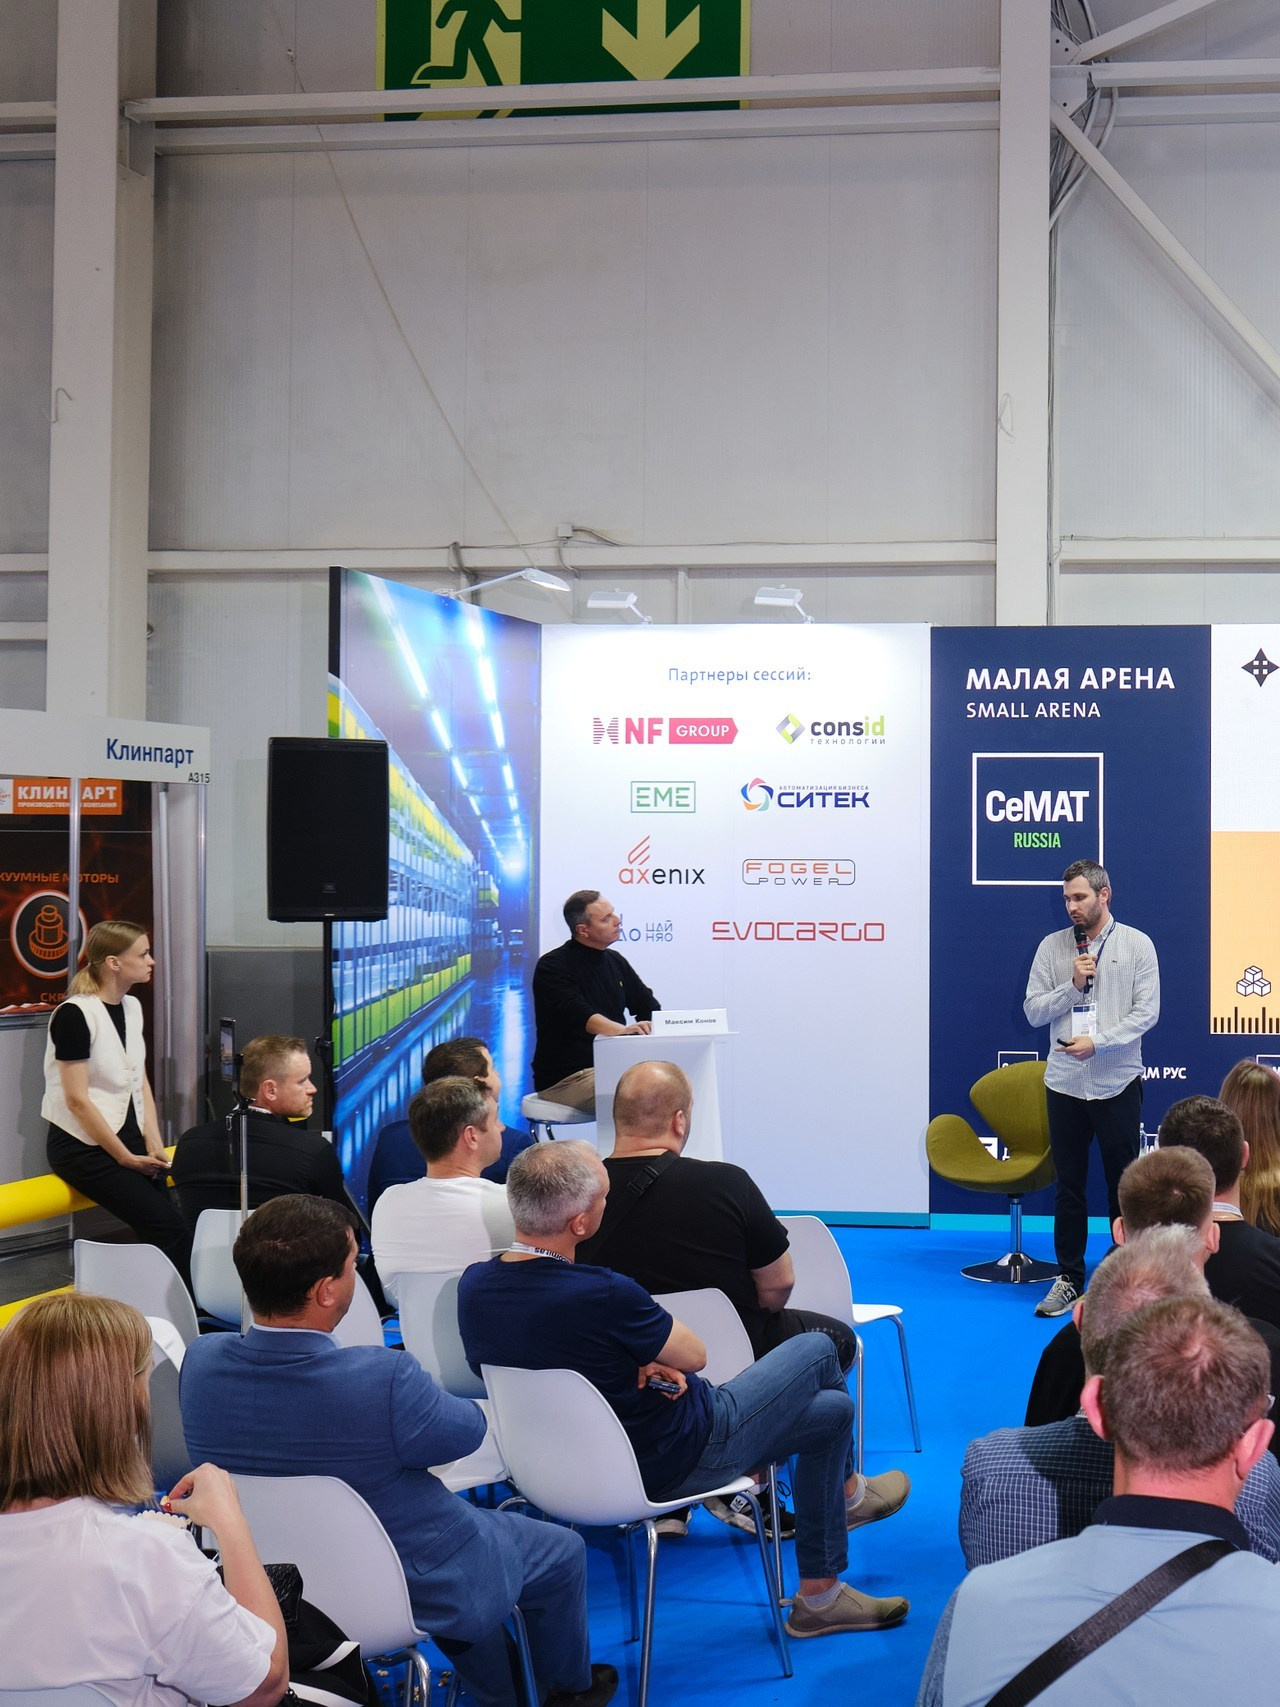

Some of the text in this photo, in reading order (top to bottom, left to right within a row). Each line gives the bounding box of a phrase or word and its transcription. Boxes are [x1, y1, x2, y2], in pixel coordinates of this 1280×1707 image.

[668, 666, 811, 685] Партнеры сессий:
[966, 667, 1176, 690] МАЛАЯ АРЕНА
[966, 702, 1101, 718] SMALL ARENA
[676, 725, 730, 737] GROUP
[810, 715, 885, 736] consid
[106, 738, 194, 768] Клинпарт
[17, 786, 118, 800] КЛИНАРТ
[636, 787, 690, 808] EME
[777, 792, 870, 808] СИТЕК
[985, 789, 1090, 823] CeMAT
[1013, 832, 1062, 848] RUSSIA
[618, 867, 706, 885] axenix
[746, 862, 852, 875] FOGEL
[758, 877, 840, 886] POWER
[1163, 1066, 1187, 1080] РУС
